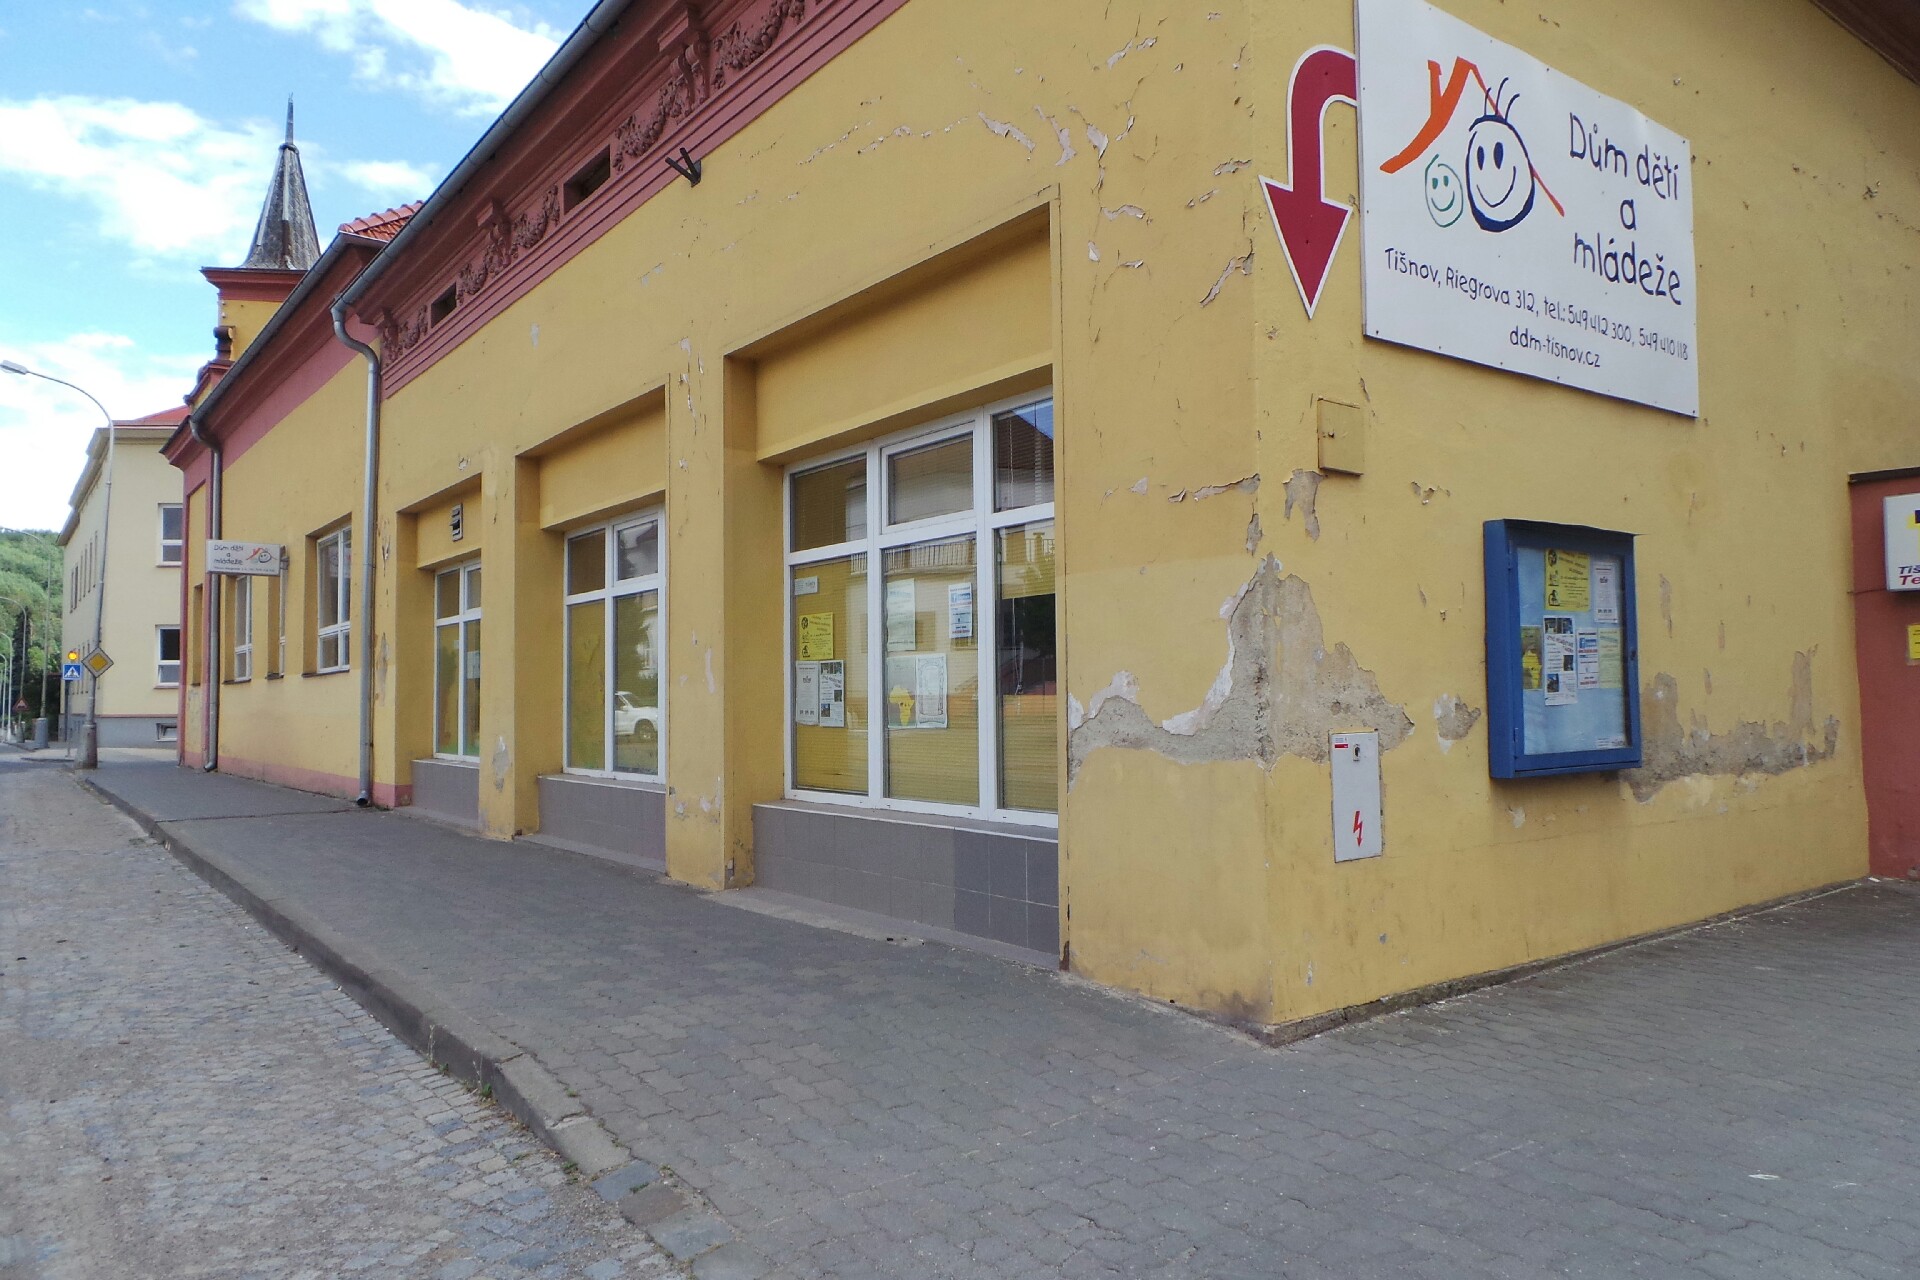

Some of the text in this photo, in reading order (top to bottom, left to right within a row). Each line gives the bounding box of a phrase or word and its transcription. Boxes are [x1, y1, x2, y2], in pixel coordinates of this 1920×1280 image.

[1569, 112, 1679, 200] Dům děti
[1620, 199, 1637, 231] a
[1384, 247, 1441, 289] Tišnov,
[1446, 266, 1511, 306] Riegrova
[1515, 289, 1539, 318] 312,
[1568, 304, 1588, 331] 549
[1590, 314, 1609, 337] 412
[1611, 321, 1635, 348] 300,
[1639, 327, 1658, 352] 549
[1660, 337, 1675, 356] 410
[1676, 343, 1689, 361] 118
[1573, 232, 1682, 306] mládeže
[1509, 325, 1601, 368] ddm-tisnov.cz
